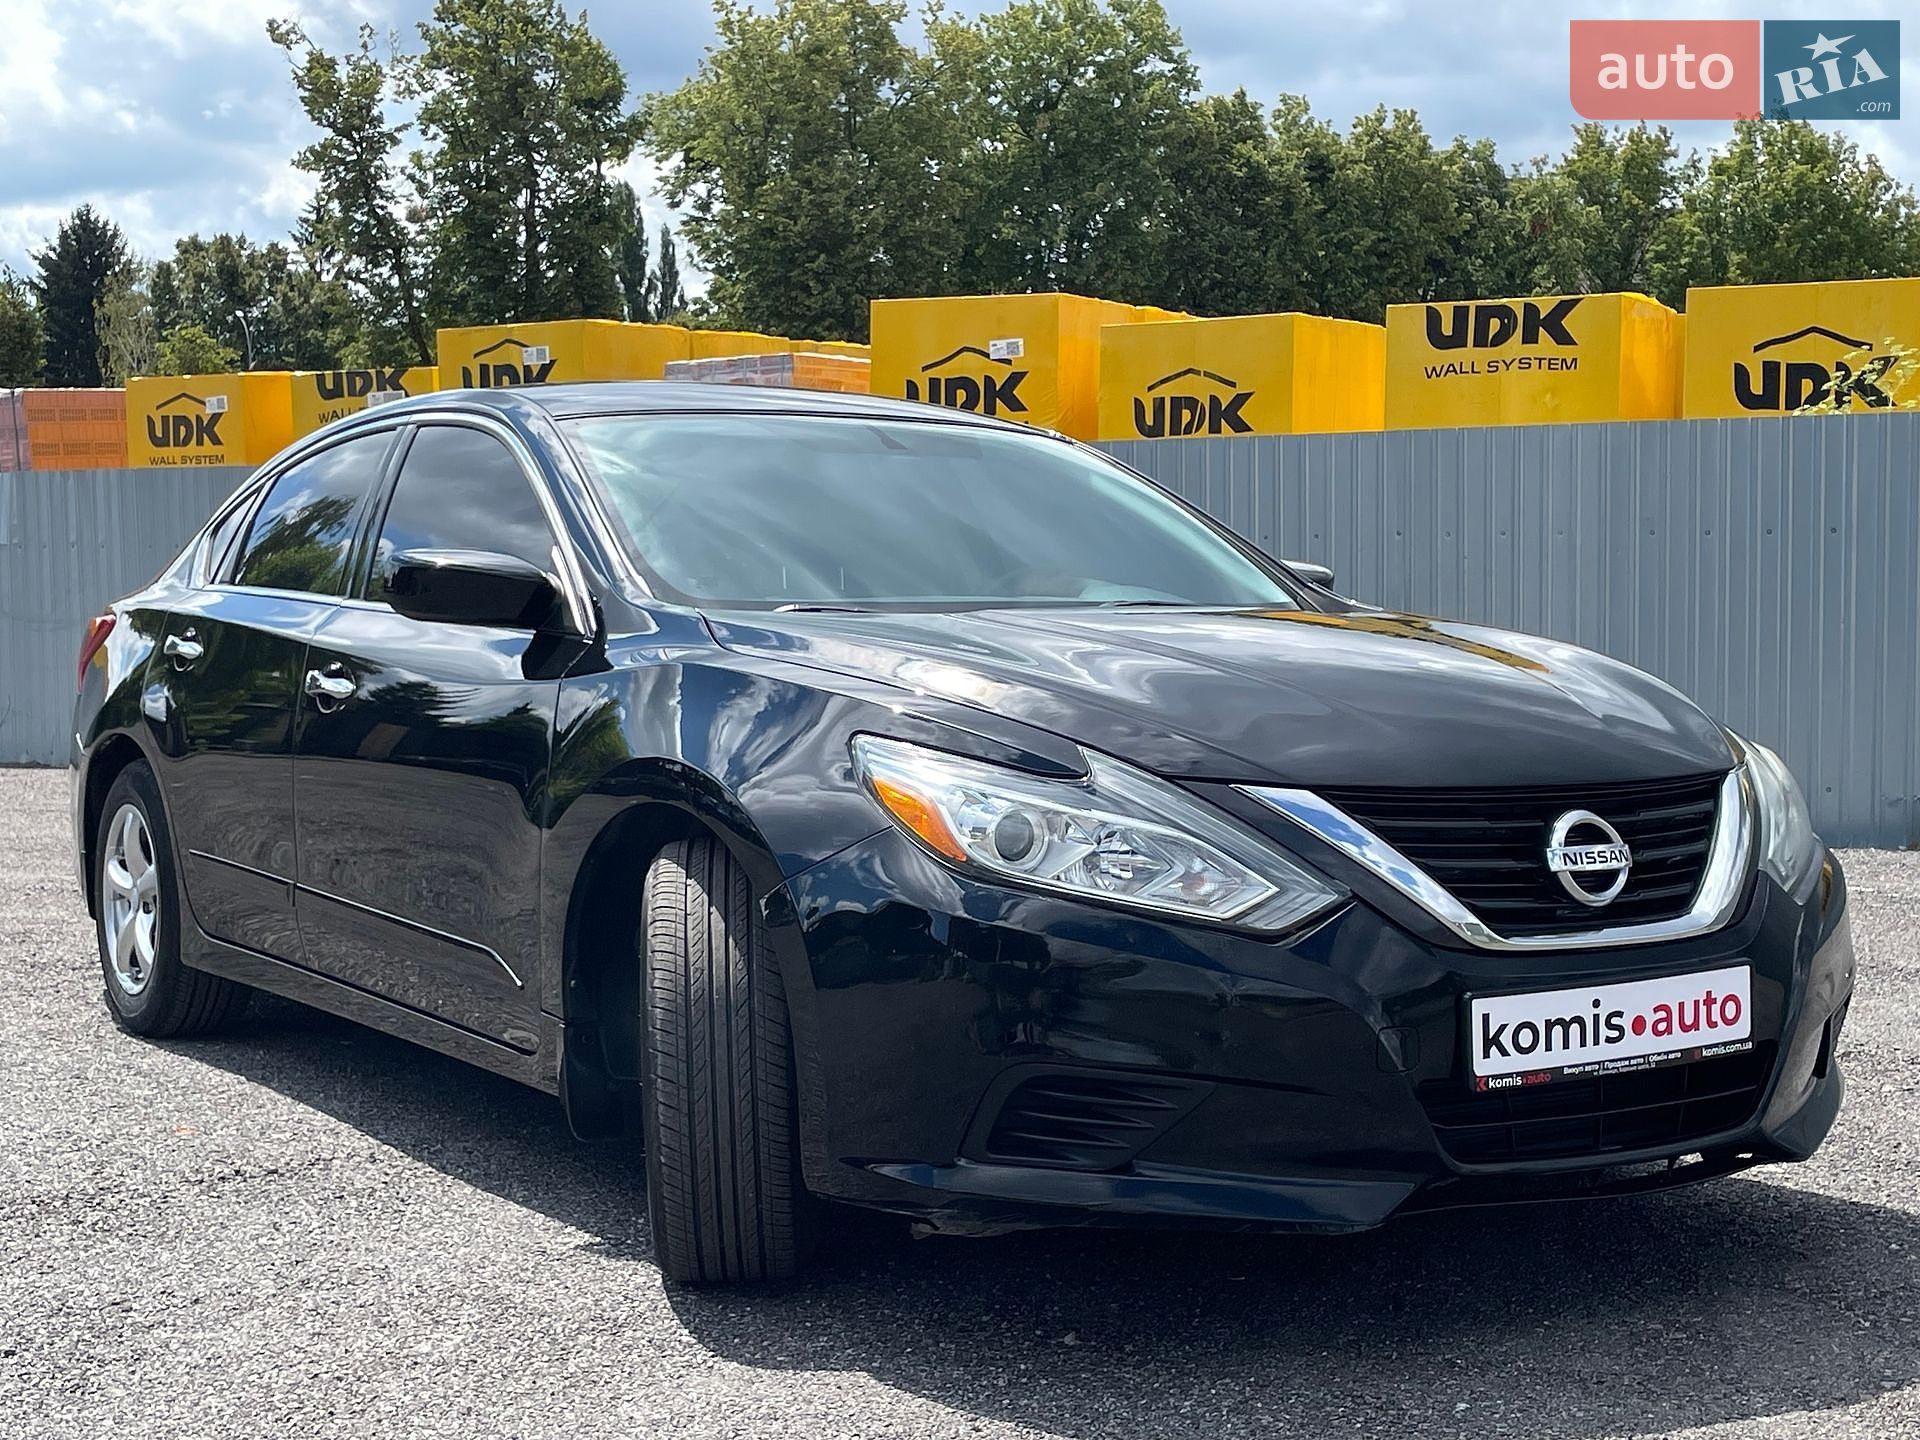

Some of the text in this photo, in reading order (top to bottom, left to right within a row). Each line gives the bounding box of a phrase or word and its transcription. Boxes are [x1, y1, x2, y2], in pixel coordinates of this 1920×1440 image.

[1426, 298, 1584, 350] UDK
[1424, 356, 1578, 380] WALL SYSTEM
[1734, 355, 1899, 411] UDK
[316, 369, 411, 400] UDK
[147, 412, 224, 448] UDK
[1133, 391, 1256, 439] UDK
[149, 454, 225, 466] WALL SYSTEM
[1562, 849, 1629, 866] NISSAN
[1701, 1041, 1753, 1057] komis.com.ua
